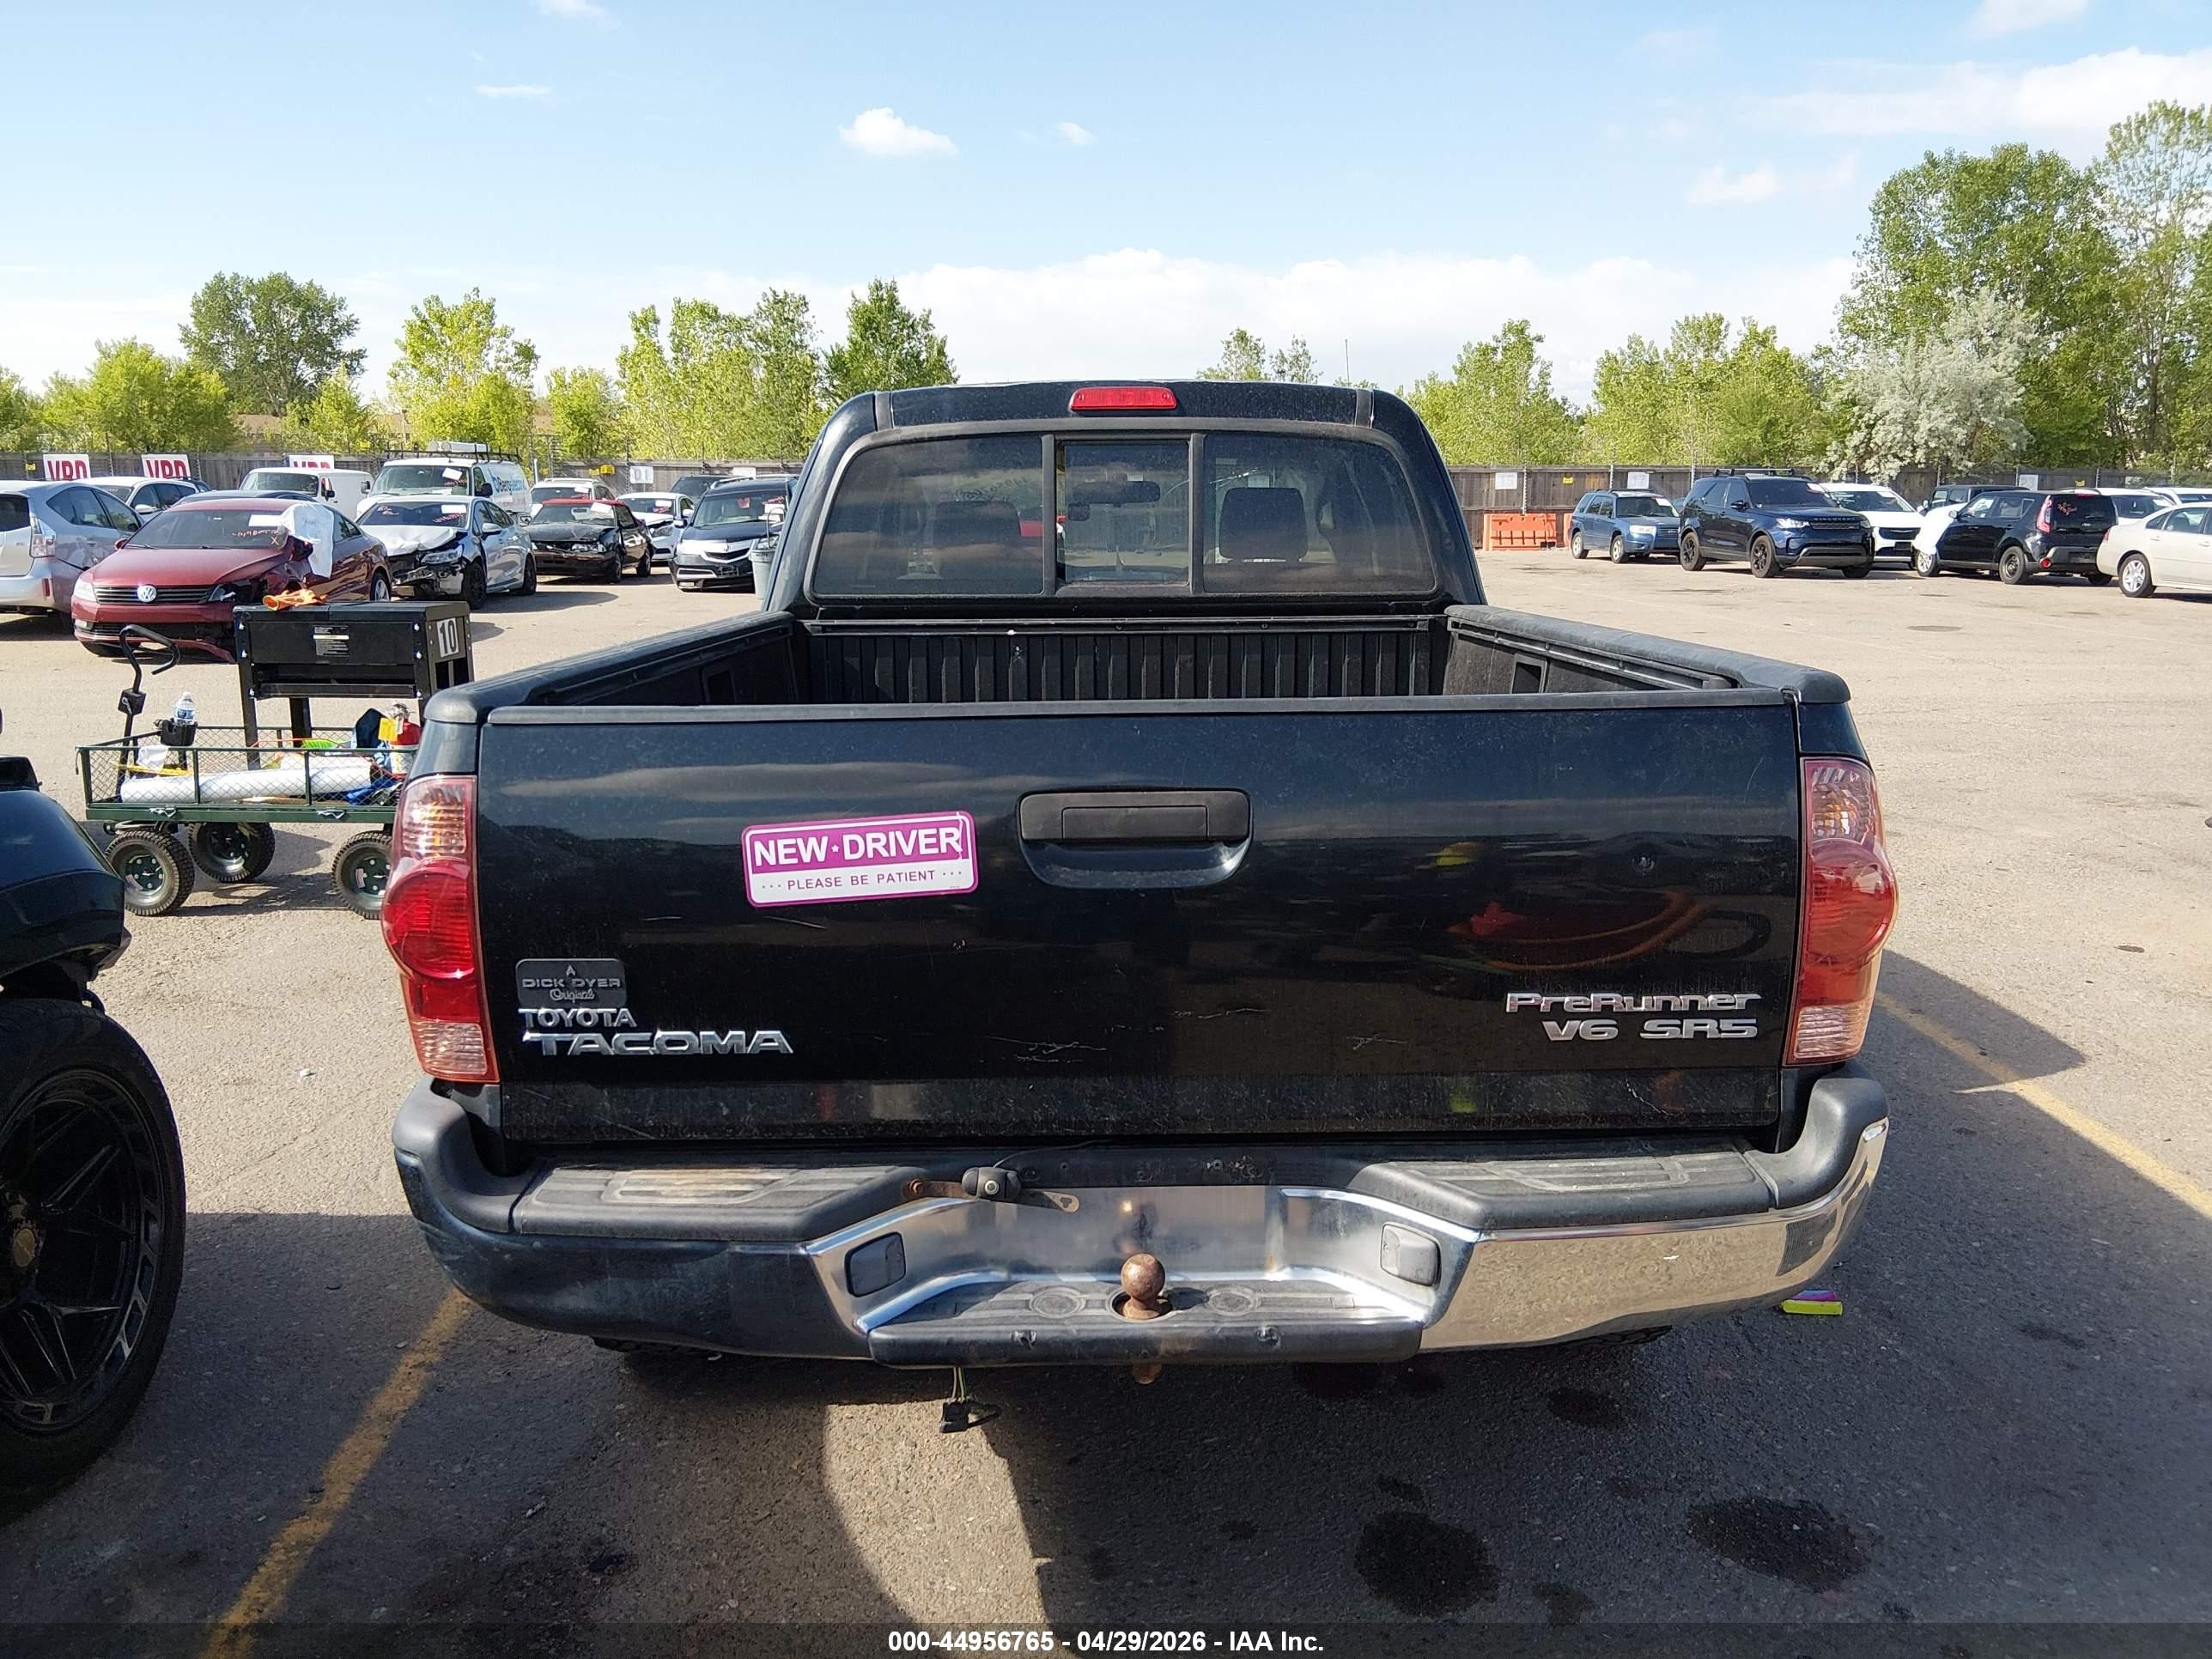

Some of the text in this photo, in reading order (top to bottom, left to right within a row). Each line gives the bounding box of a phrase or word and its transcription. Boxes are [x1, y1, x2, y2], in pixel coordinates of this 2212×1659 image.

[439, 620, 458, 655] 10
[753, 826, 963, 866] NEW DRIVER
[787, 870, 936, 890] PLEASE BE PATIENT
[565, 964, 576, 976] A
[522, 978, 621, 988] DICK DYER
[1505, 993, 1763, 1013] PreRunner
[518, 1007, 638, 1028] TOYOTA
[1541, 1018, 1758, 1041] V6 SR5
[522, 1029, 794, 1056] TACOMA
